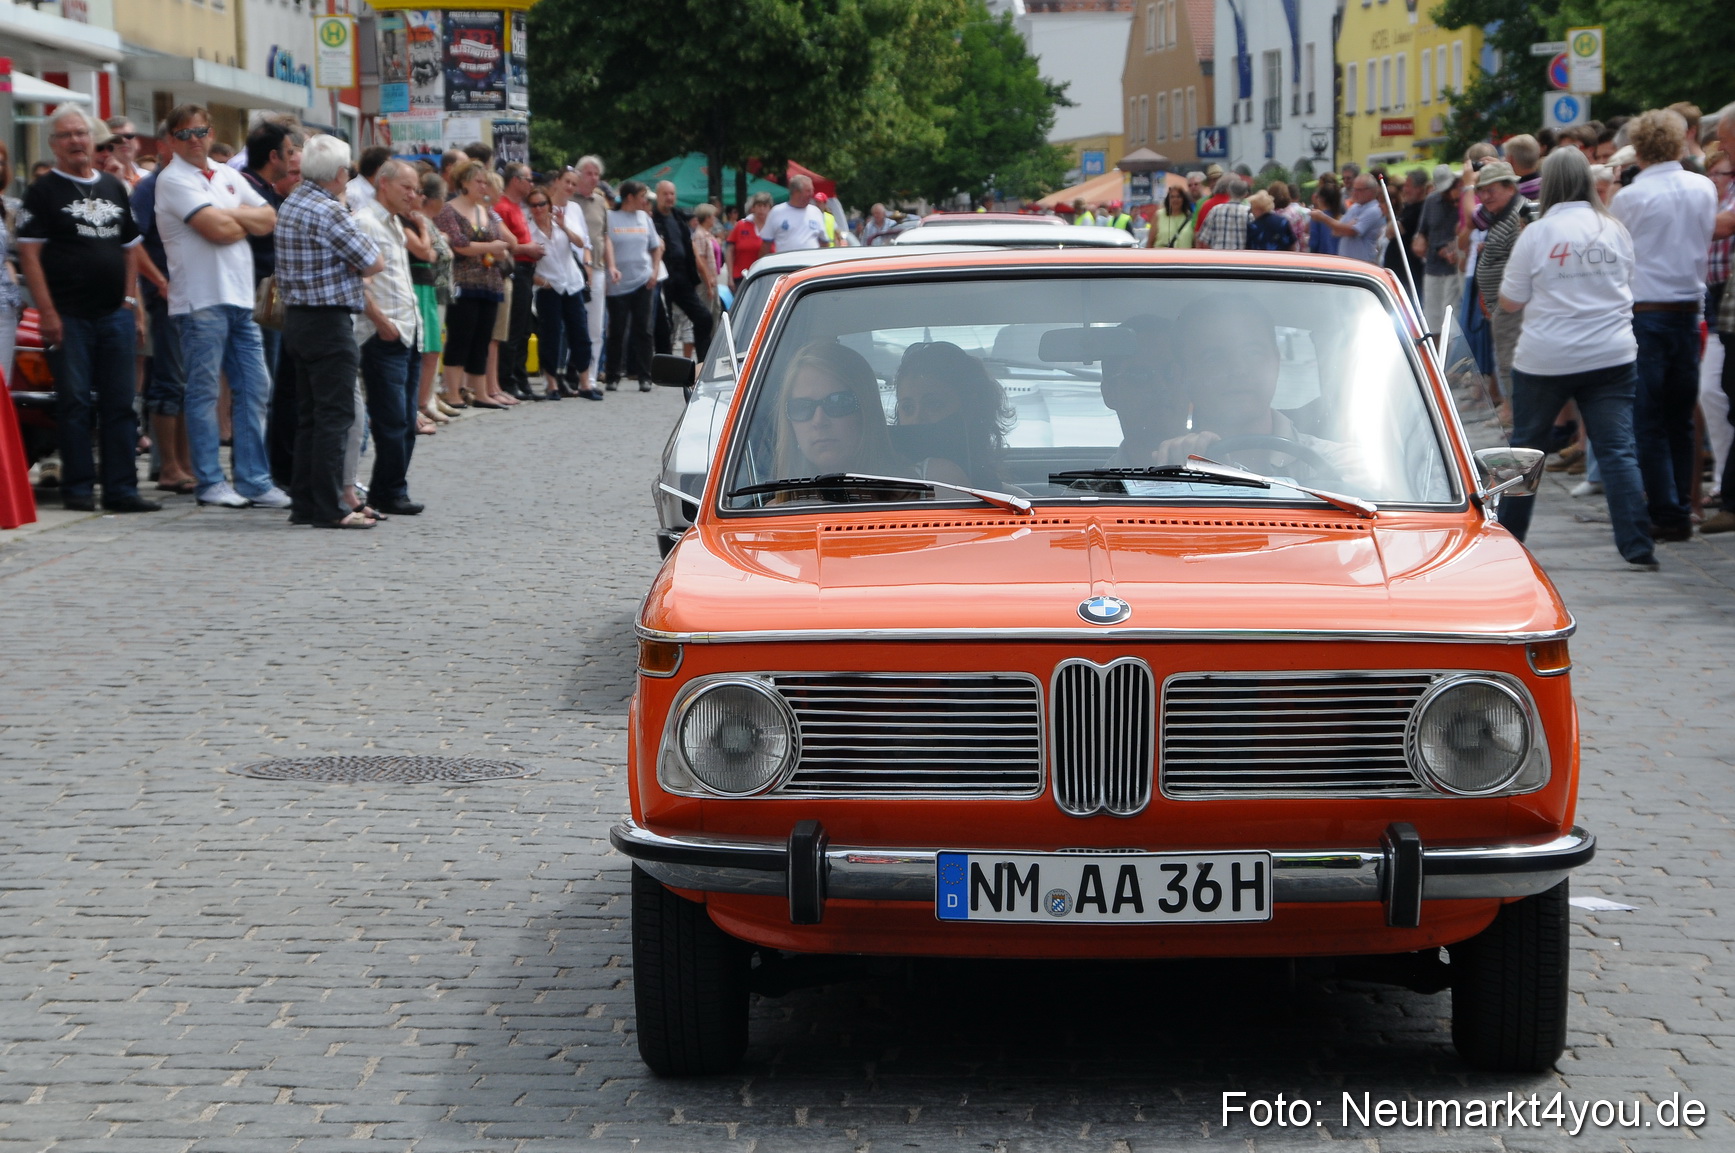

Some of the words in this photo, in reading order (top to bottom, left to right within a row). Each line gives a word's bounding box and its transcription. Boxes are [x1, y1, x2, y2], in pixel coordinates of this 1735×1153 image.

[449, 44, 500, 59] ALTSTADTFEST
[1573, 248, 1618, 265] YOU
[1083, 596, 1127, 606] BMW
[970, 862, 1039, 913] NM
[1075, 865, 1144, 914] AA
[947, 894, 957, 907] D
